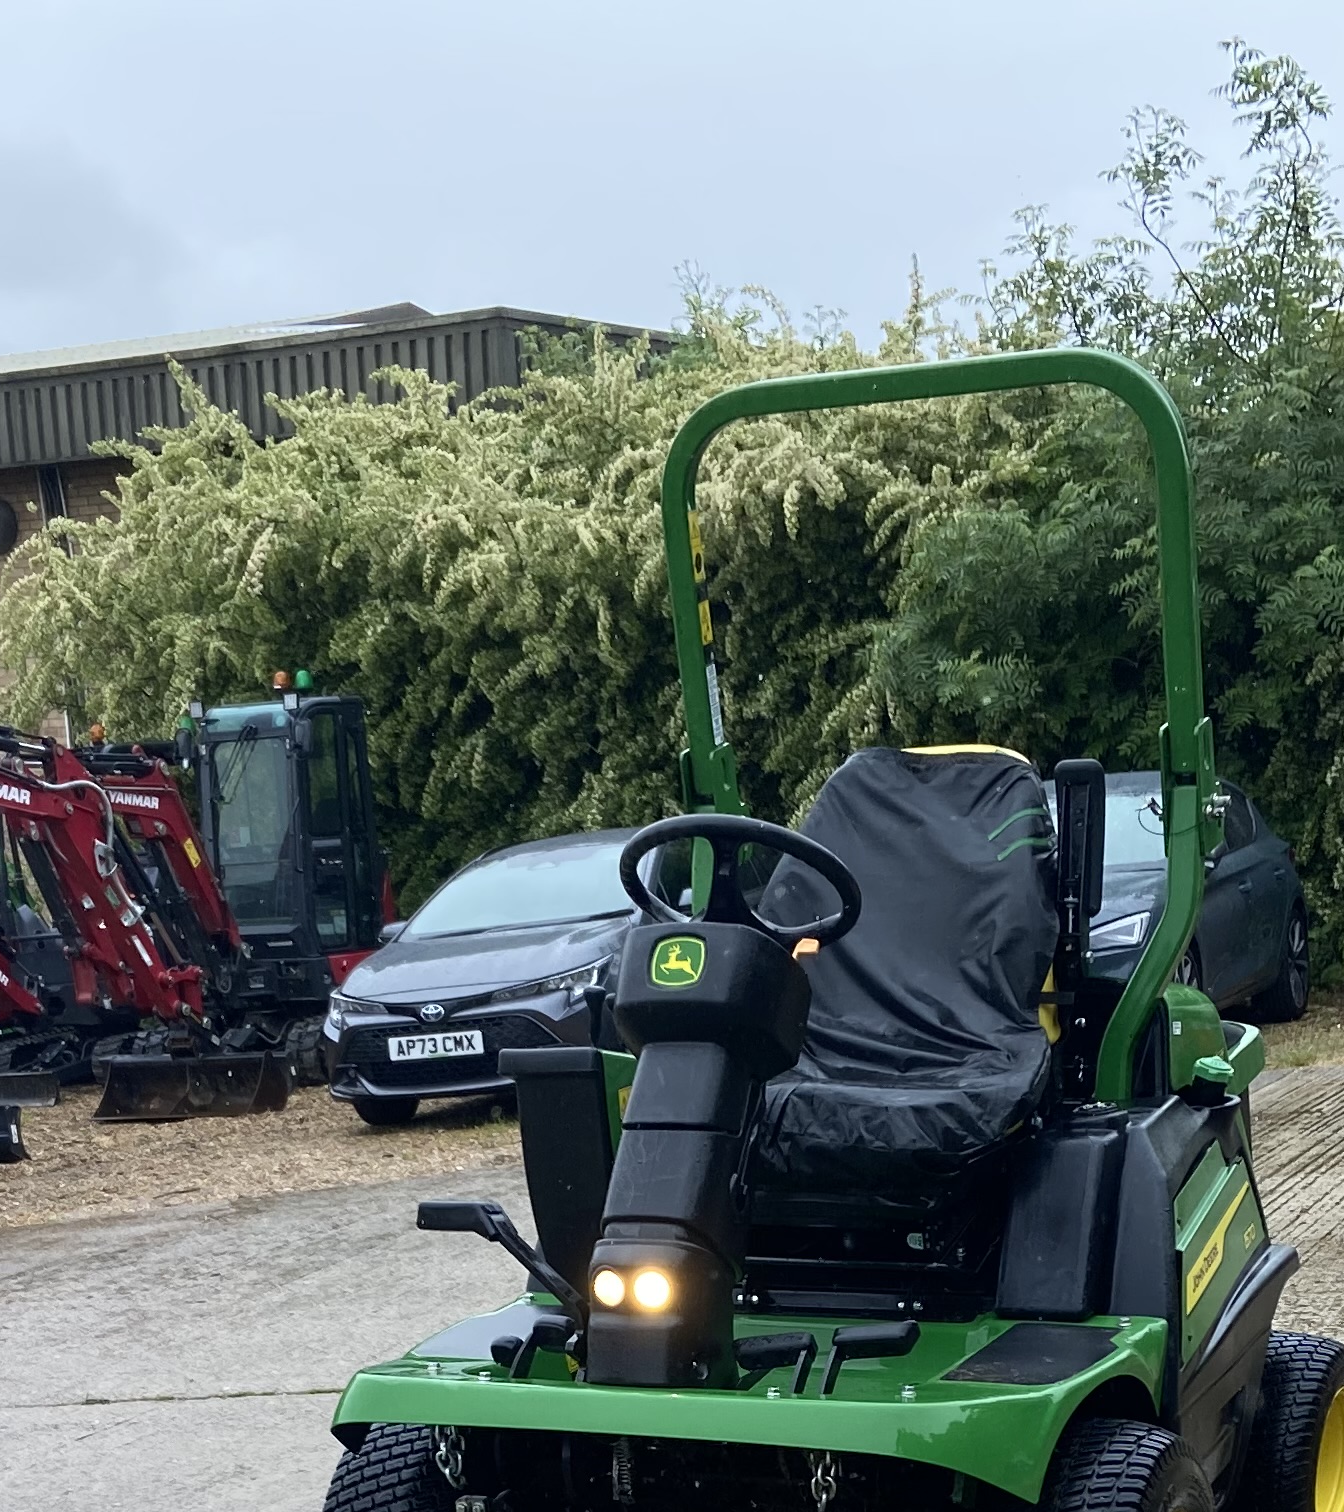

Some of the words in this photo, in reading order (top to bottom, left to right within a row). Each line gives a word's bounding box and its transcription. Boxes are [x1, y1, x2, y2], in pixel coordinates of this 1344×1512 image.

[107, 790, 160, 810] YANMAR
[397, 1037, 438, 1057] AP73
[442, 1034, 476, 1053] CMX
